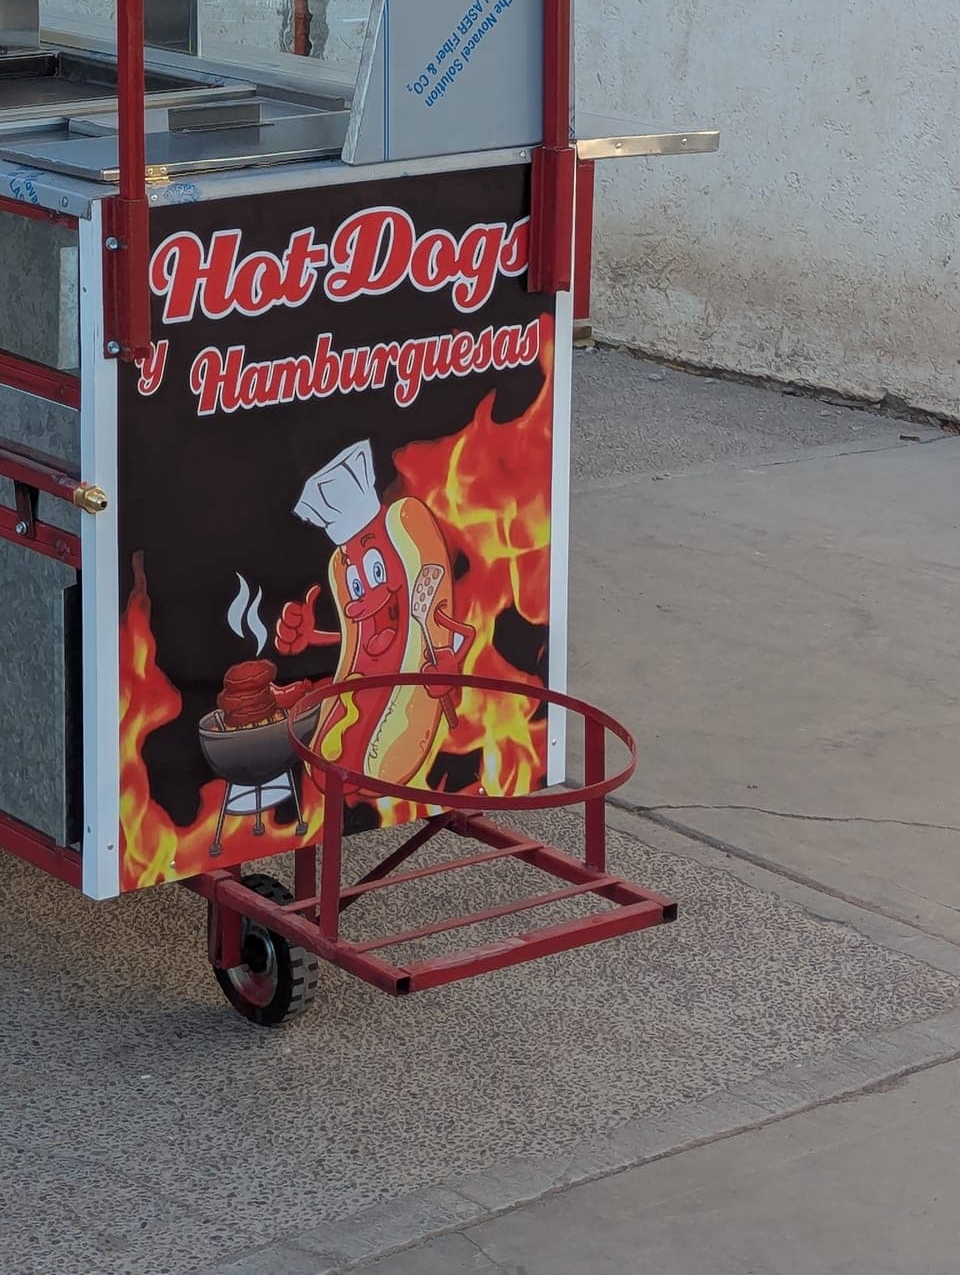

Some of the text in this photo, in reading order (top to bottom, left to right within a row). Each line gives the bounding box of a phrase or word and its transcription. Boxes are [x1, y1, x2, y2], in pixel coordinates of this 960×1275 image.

[435, 32, 461, 65] Fiber
[460, 12, 498, 62] Novacel
[424, 58, 464, 108] Solution
[426, 62, 438, 75] &
[150, 205, 531, 325] Hot Dogs
[190, 319, 541, 416] Hamburguesas
